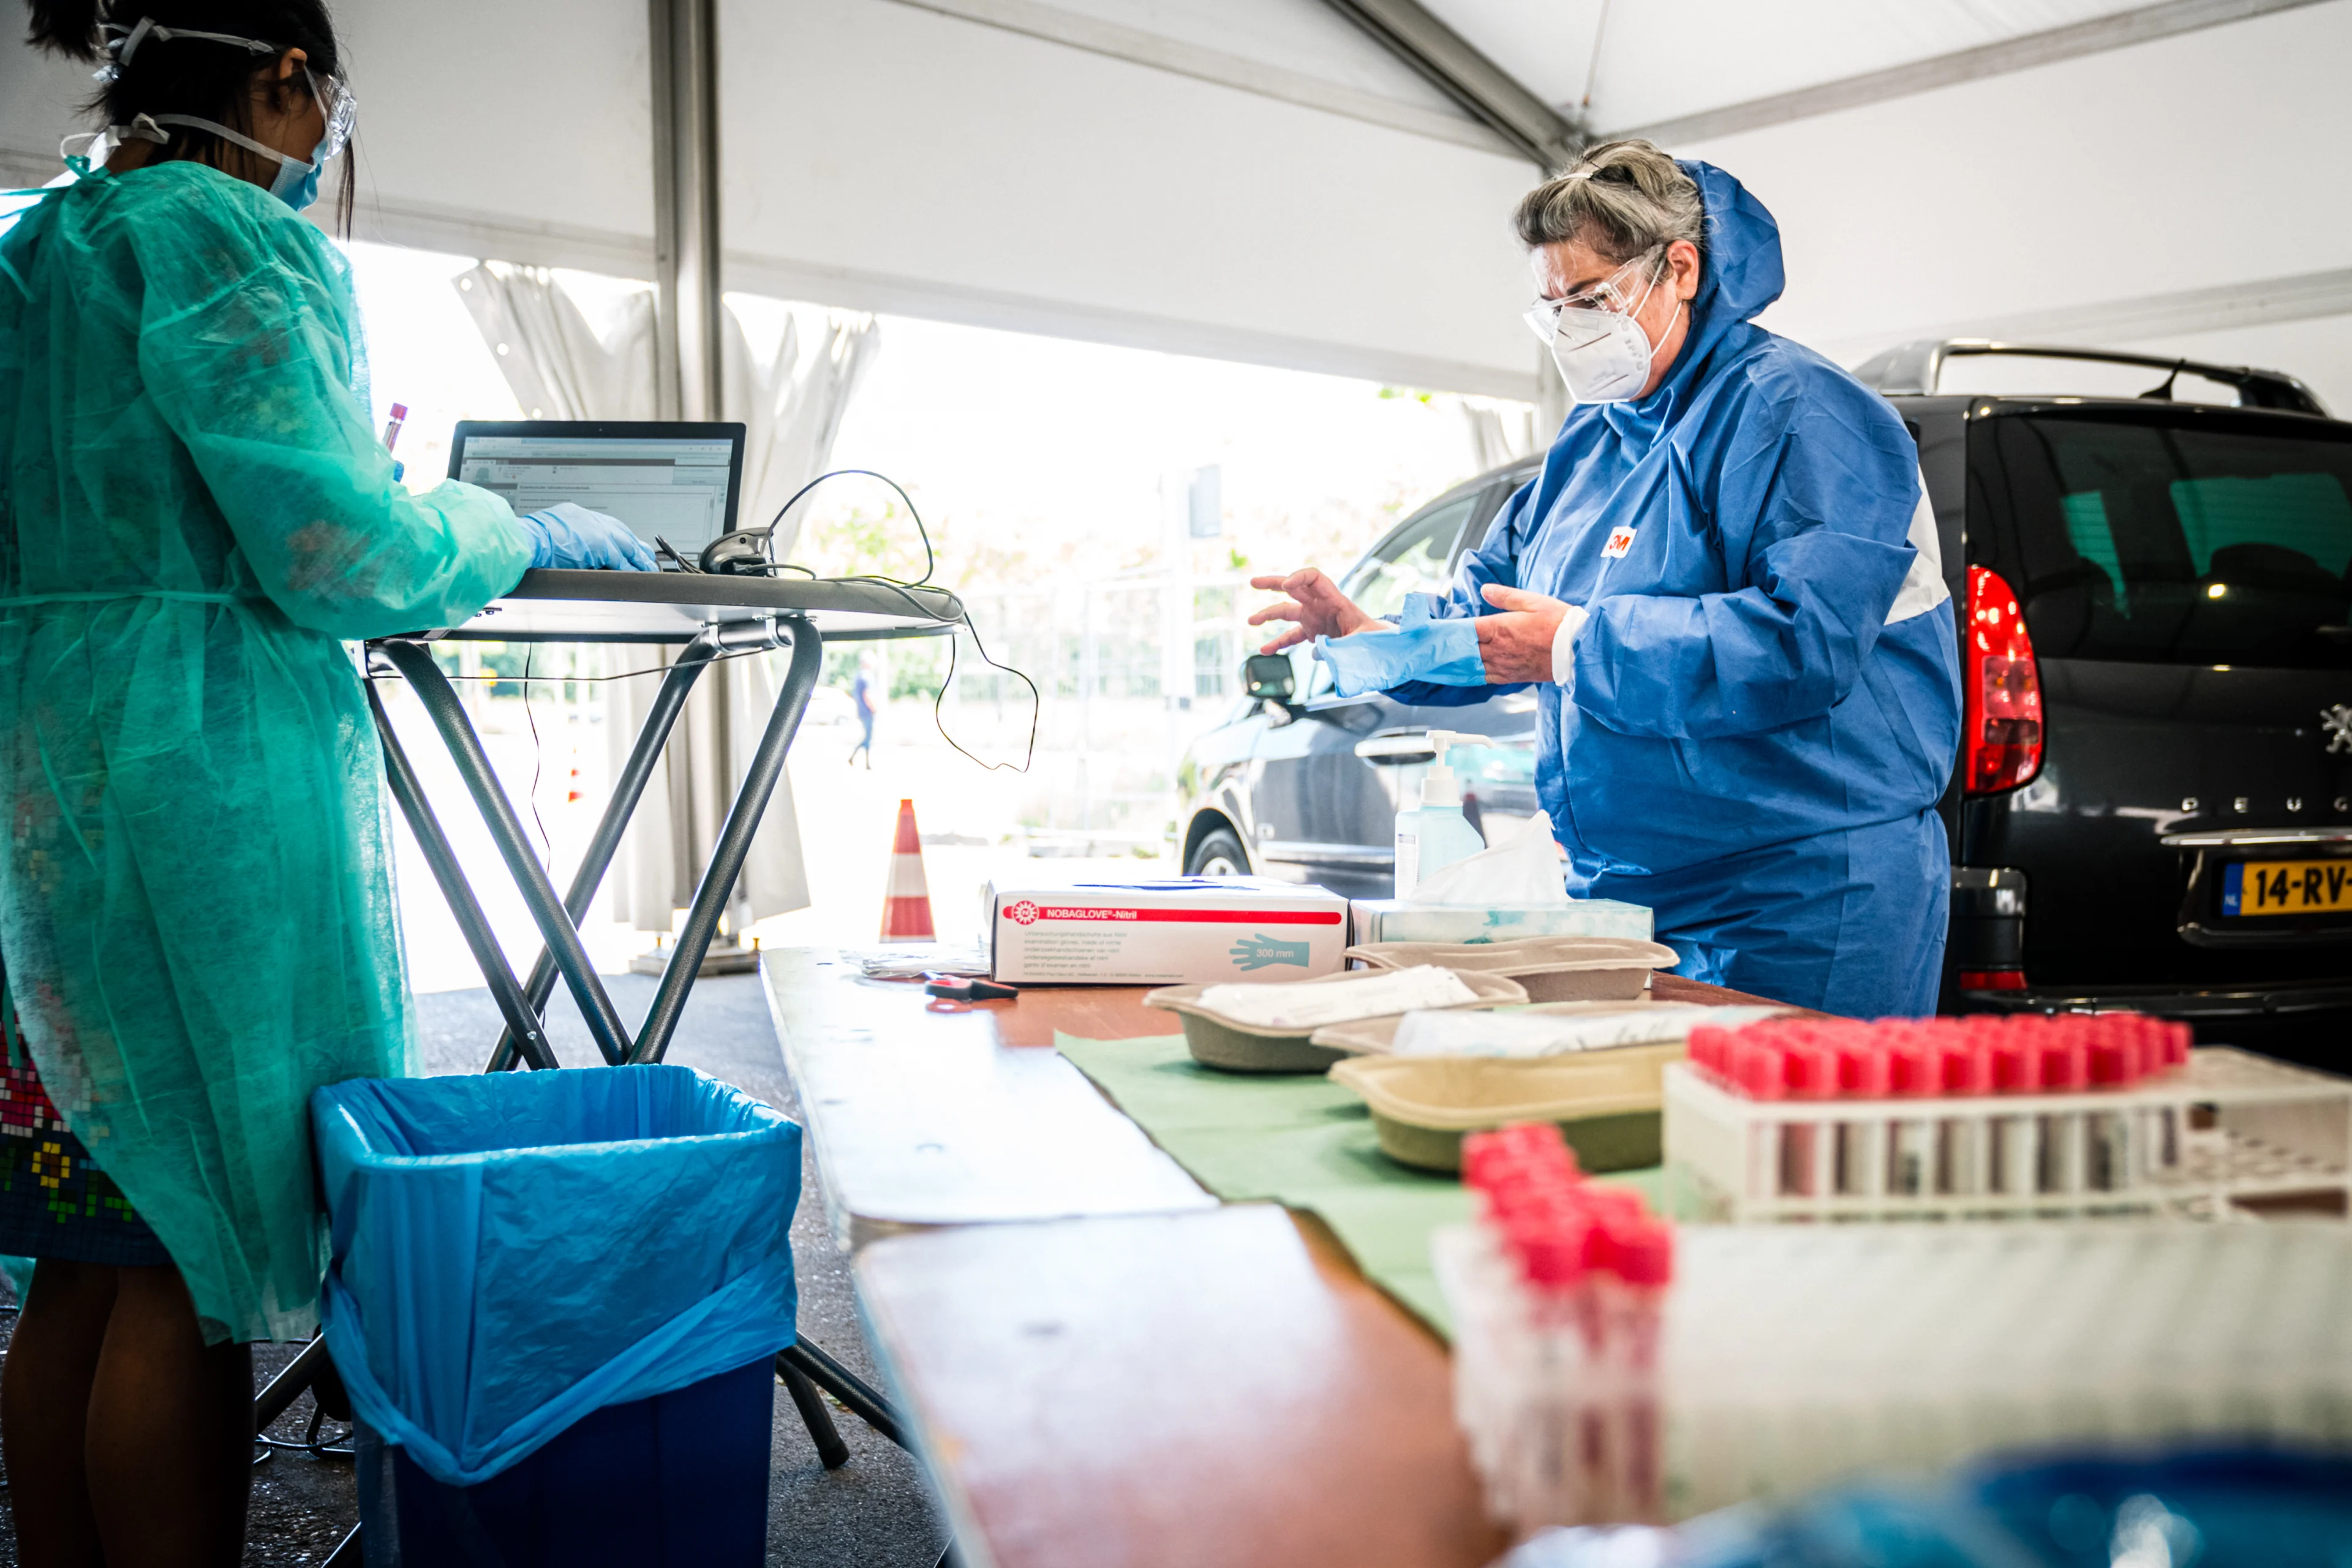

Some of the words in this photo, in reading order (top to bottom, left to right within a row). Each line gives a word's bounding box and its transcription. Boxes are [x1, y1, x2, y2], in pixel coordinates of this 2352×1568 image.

[1610, 535, 1630, 551] 3M
[2225, 894, 2238, 906] NL
[1047, 909, 1137, 919] NOBAGLOVE®-Nitril
[1256, 948, 1273, 957] 300
